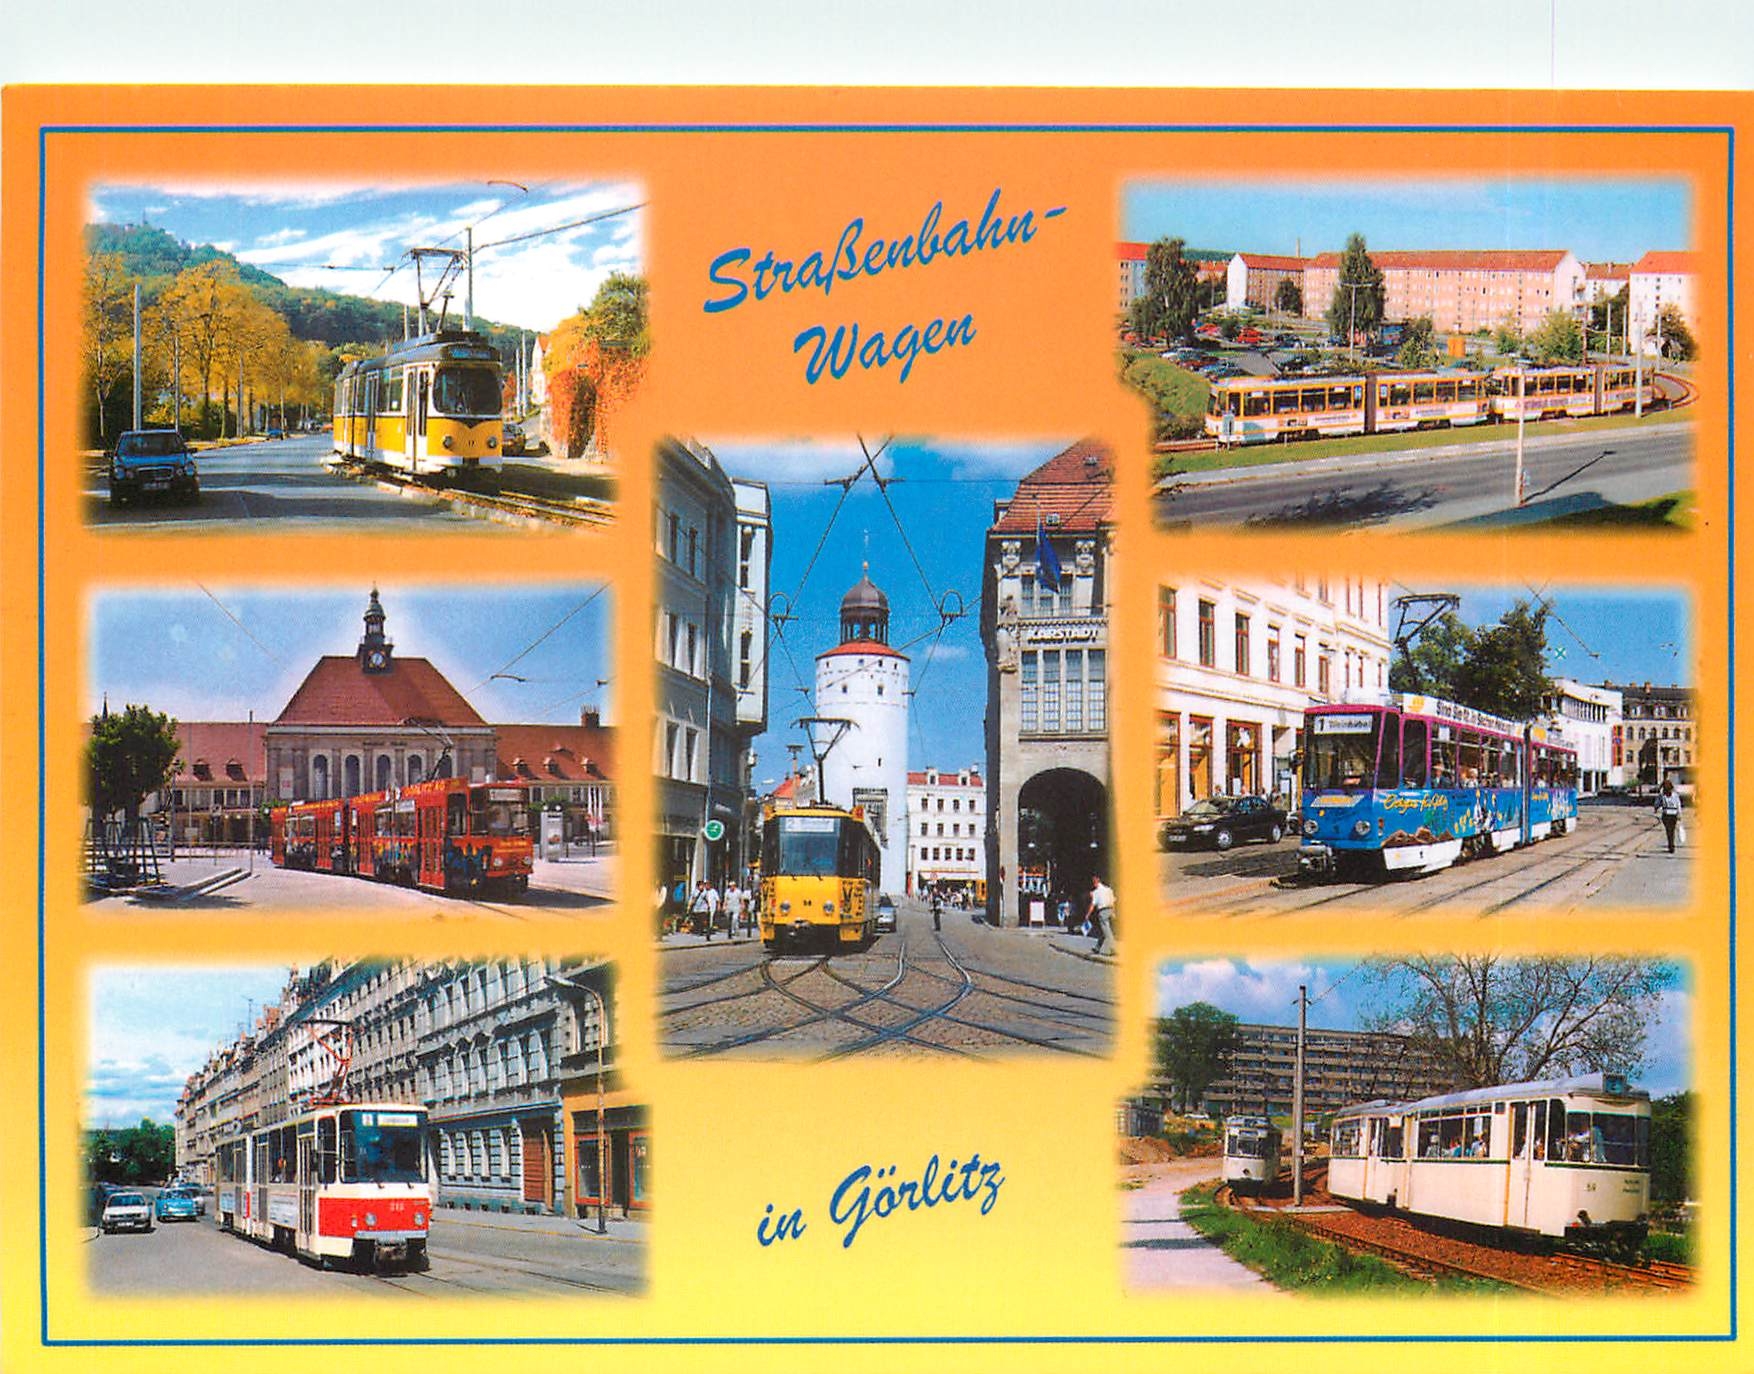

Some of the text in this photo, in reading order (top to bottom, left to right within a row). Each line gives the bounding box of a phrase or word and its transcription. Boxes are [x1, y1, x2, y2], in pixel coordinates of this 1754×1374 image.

[703, 188, 1067, 313] Straßenbahn-
[794, 313, 977, 384] Wagen
[757, 1152, 1005, 1248] in Görlitz
